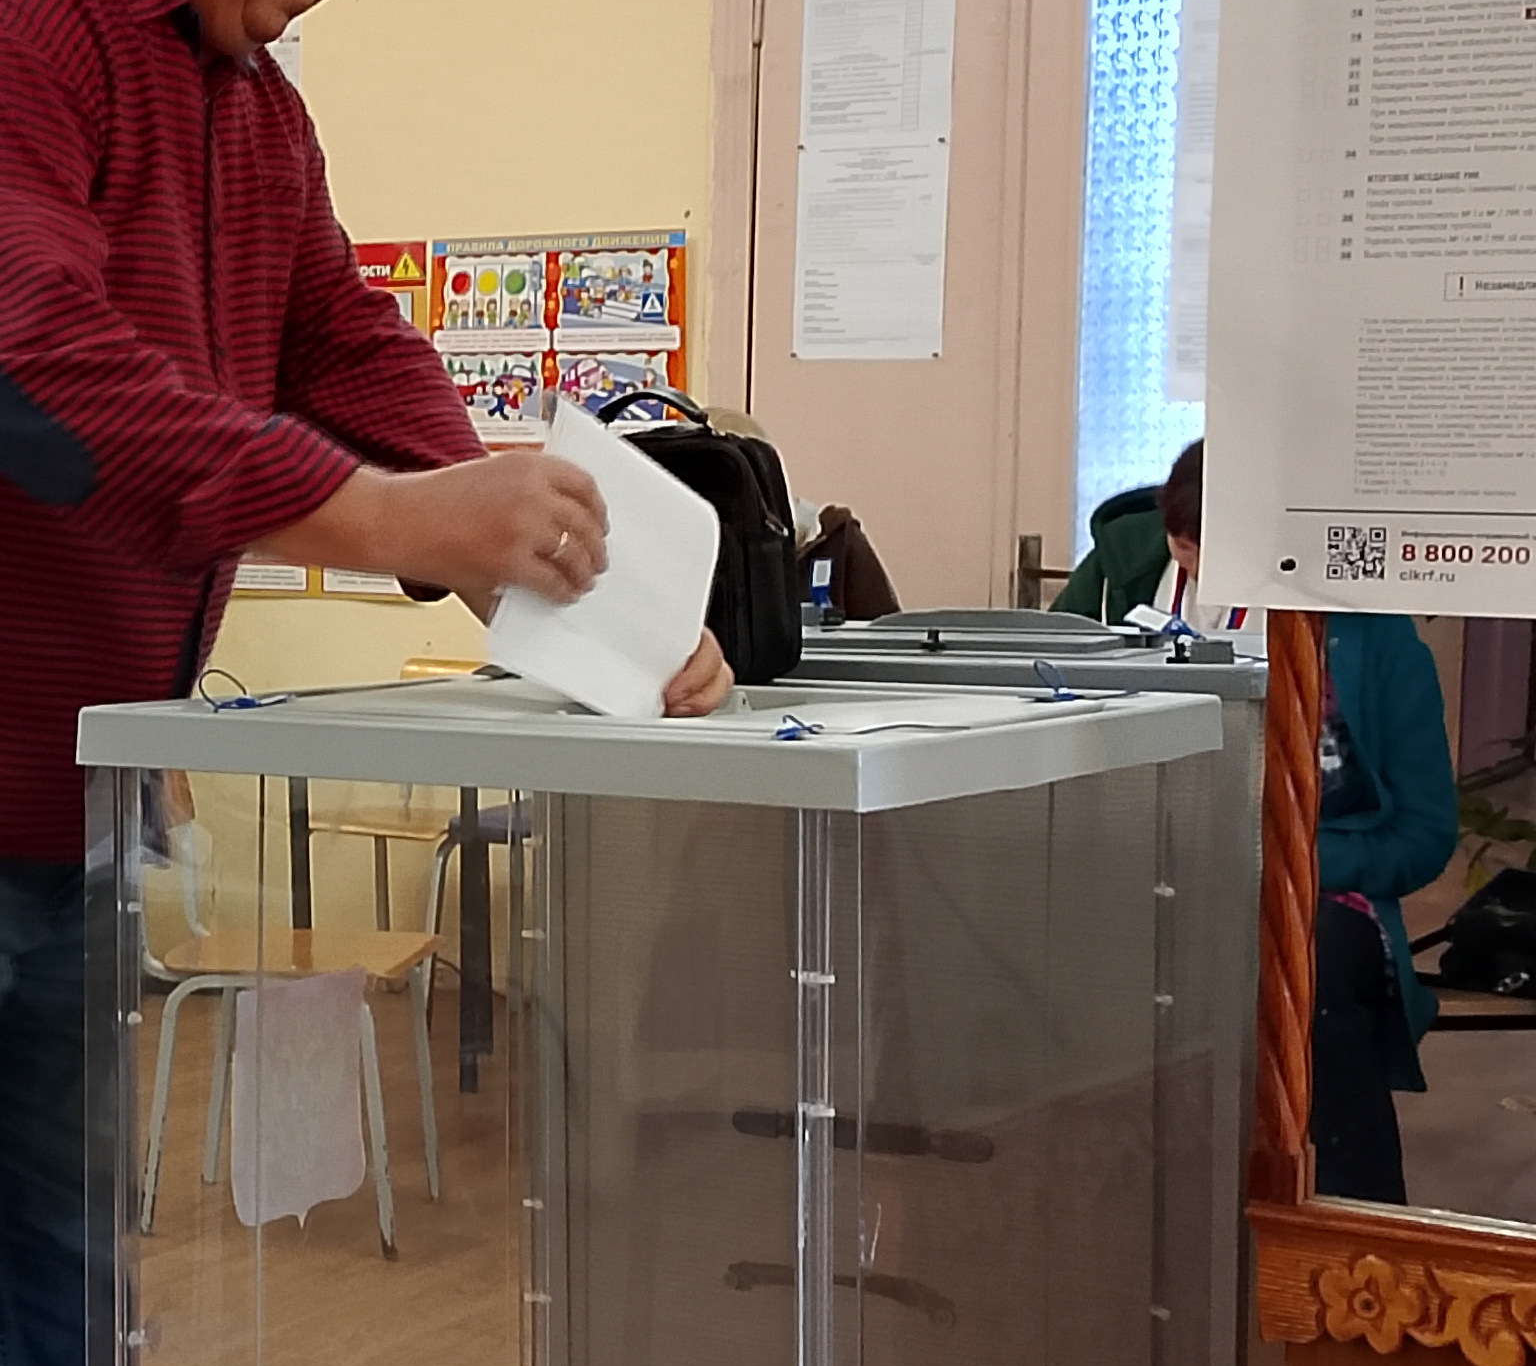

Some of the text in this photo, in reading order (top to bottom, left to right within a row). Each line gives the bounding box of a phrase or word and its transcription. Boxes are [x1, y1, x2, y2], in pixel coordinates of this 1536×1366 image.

[447, 234, 669, 254] ПРАВИЛА ДОРОЖНОГО ДВИЖЕНИЯ
[1401, 543, 1531, 566] 8 800 200
